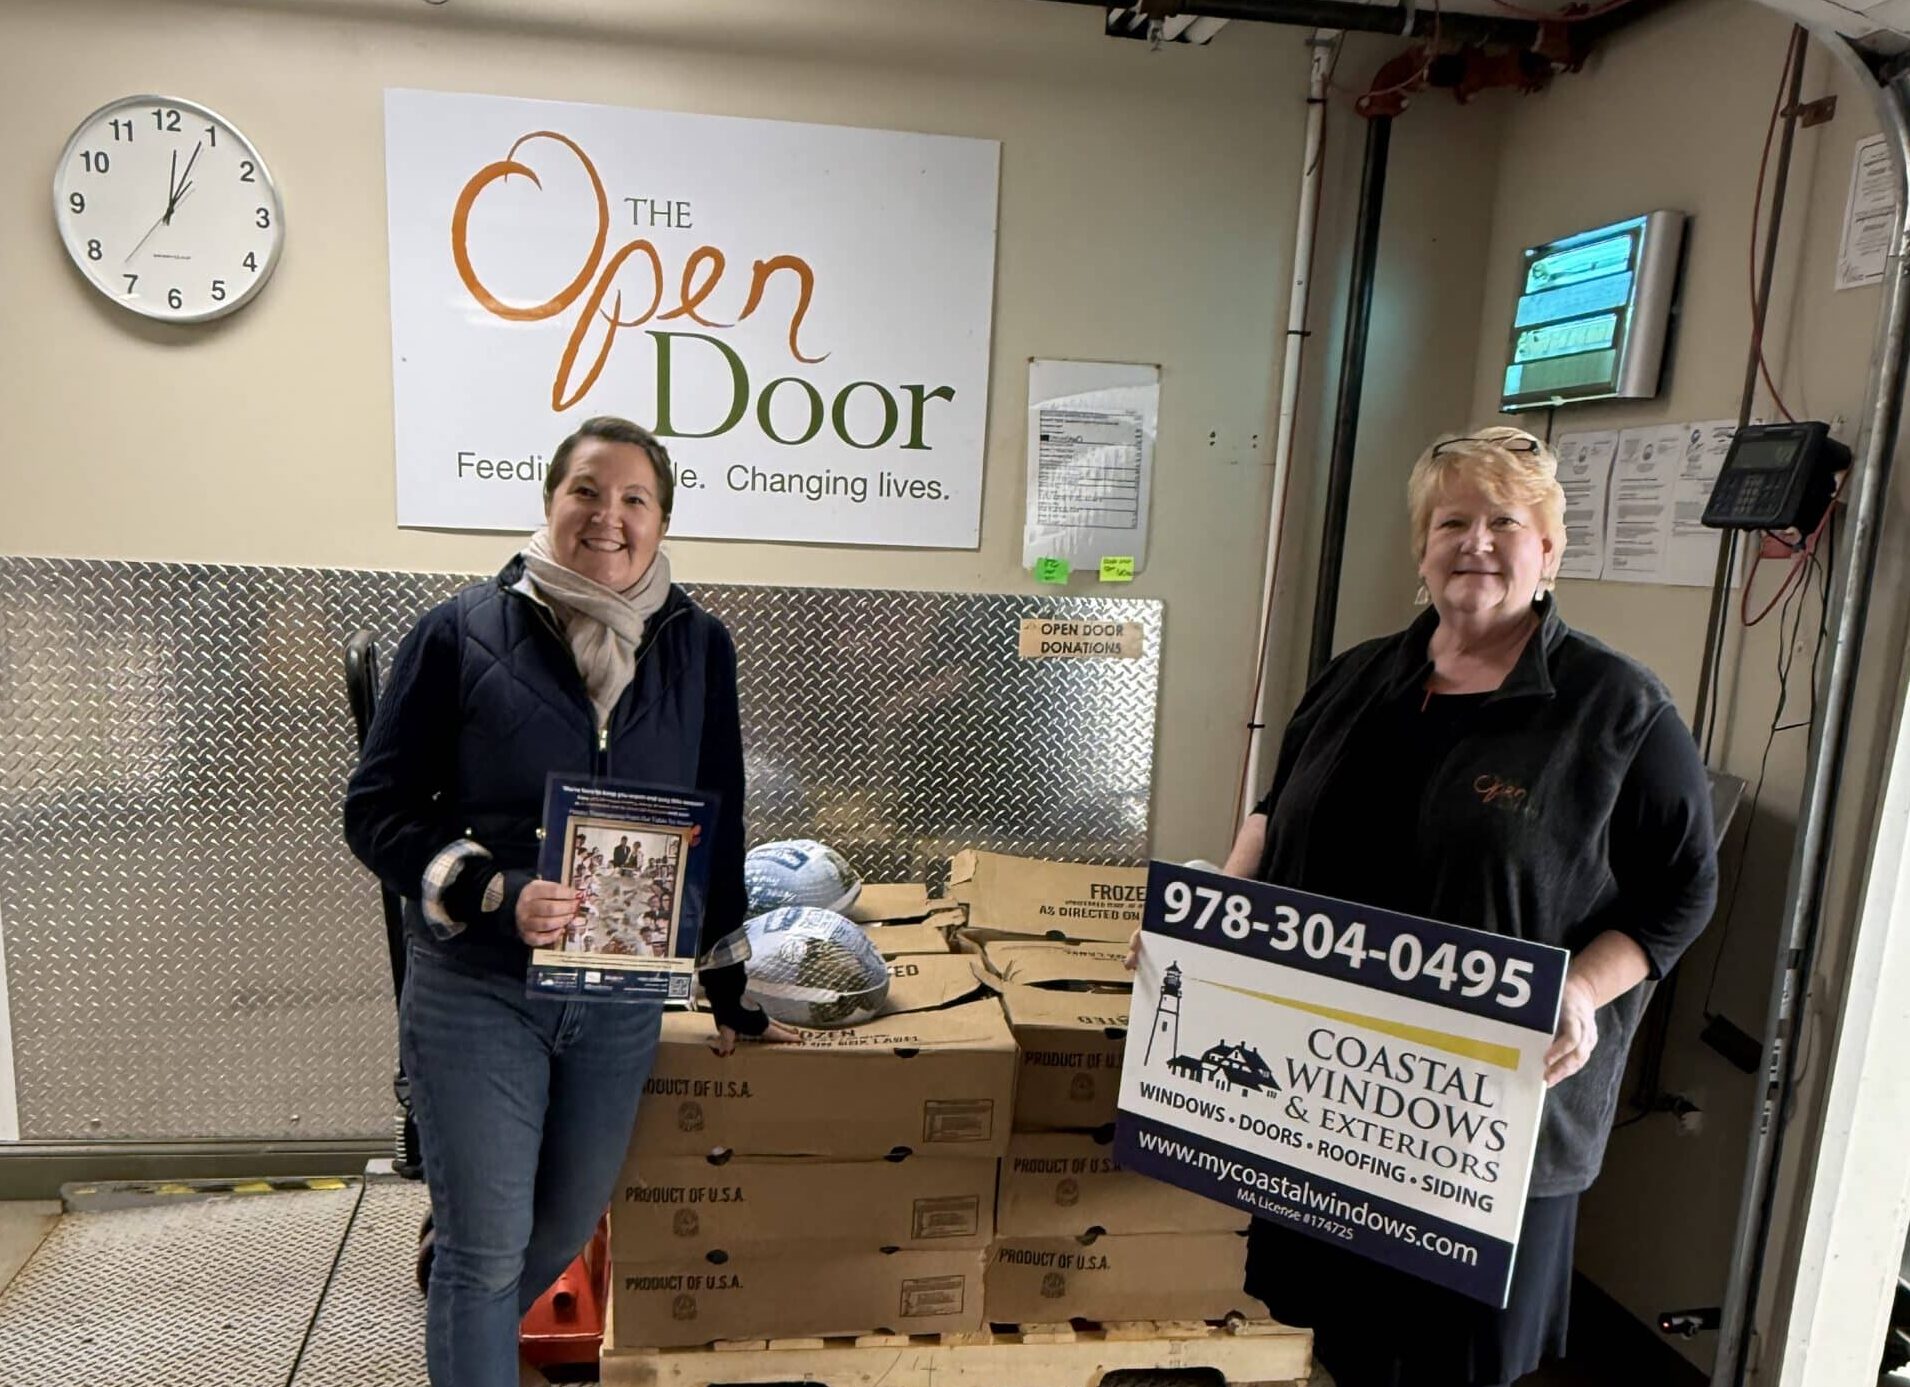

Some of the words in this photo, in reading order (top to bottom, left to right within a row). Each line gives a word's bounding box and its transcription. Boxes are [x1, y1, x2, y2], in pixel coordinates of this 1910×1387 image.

[108, 119, 133, 142] 11
[152, 109, 181, 132] 12
[205, 126, 216, 147] 1
[80, 151, 109, 173] 10
[240, 161, 255, 182] 2
[70, 192, 85, 213] 9
[624, 197, 693, 229] THE
[256, 208, 270, 228] 3
[88, 239, 102, 261] 8
[243, 252, 257, 272] 4
[452, 130, 831, 412] Open
[123, 274, 138, 294] 7
[212, 280, 225, 300] 5
[168, 289, 182, 309] 6
[457, 452, 548, 481] Feedi
[727, 465, 868, 503] Changing
[878, 471, 950, 500] lives.
[1041, 623, 1078, 635] OPEN
[1083, 624, 1123, 636] DOOR
[1041, 642, 1121, 653] DONATIONS
[1091, 884, 1148, 901] FROZE
[1040, 905, 1055, 916] AS
[1059, 907, 1119, 920] DIRECTED
[1123, 911, 1140, 920] ON
[1163, 881, 1535, 1008] 978-304-0495
[801, 1029, 855, 1039] OZEN
[1025, 1051, 1084, 1069] PRODUCT
[1087, 1053, 1104, 1069] OF
[1308, 1028, 1494, 1107] COASTAL
[643, 1078, 690, 1095] ODUCT
[694, 1080, 712, 1097] OF
[714, 1081, 753, 1098] U.S.A.
[1285, 1058, 1509, 1152] WINDOWS
[1140, 1081, 1226, 1123] WINDOWS
[1239, 1114, 1303, 1148] DOORS
[1317, 1140, 1406, 1183] ROOFING
[1421, 1175, 1494, 1213] SIDING
[1285, 1096, 1311, 1123] &
[1319, 1107, 1500, 1182] EXTERIORS
[1014, 1157, 1068, 1173] PRODUCT
[1071, 1158, 1088, 1173] OF
[626, 1186, 686, 1203] PRODUCT
[689, 1187, 705, 1203] OF
[1138, 1131, 1478, 1266] www.mycoastalwindows.com
[1237, 1188, 1256, 1205] MA
[1258, 1196, 1301, 1221] License
[1303, 1213, 1354, 1240] #174725
[999, 1249, 1056, 1267] PRODUCT
[1058, 1253, 1074, 1268] OF
[1077, 1254, 1111, 1270] U.S.A.
[626, 1275, 684, 1290] PRODUCT
[687, 1275, 703, 1290] OF
[706, 1275, 743, 1290] U.S.A.
